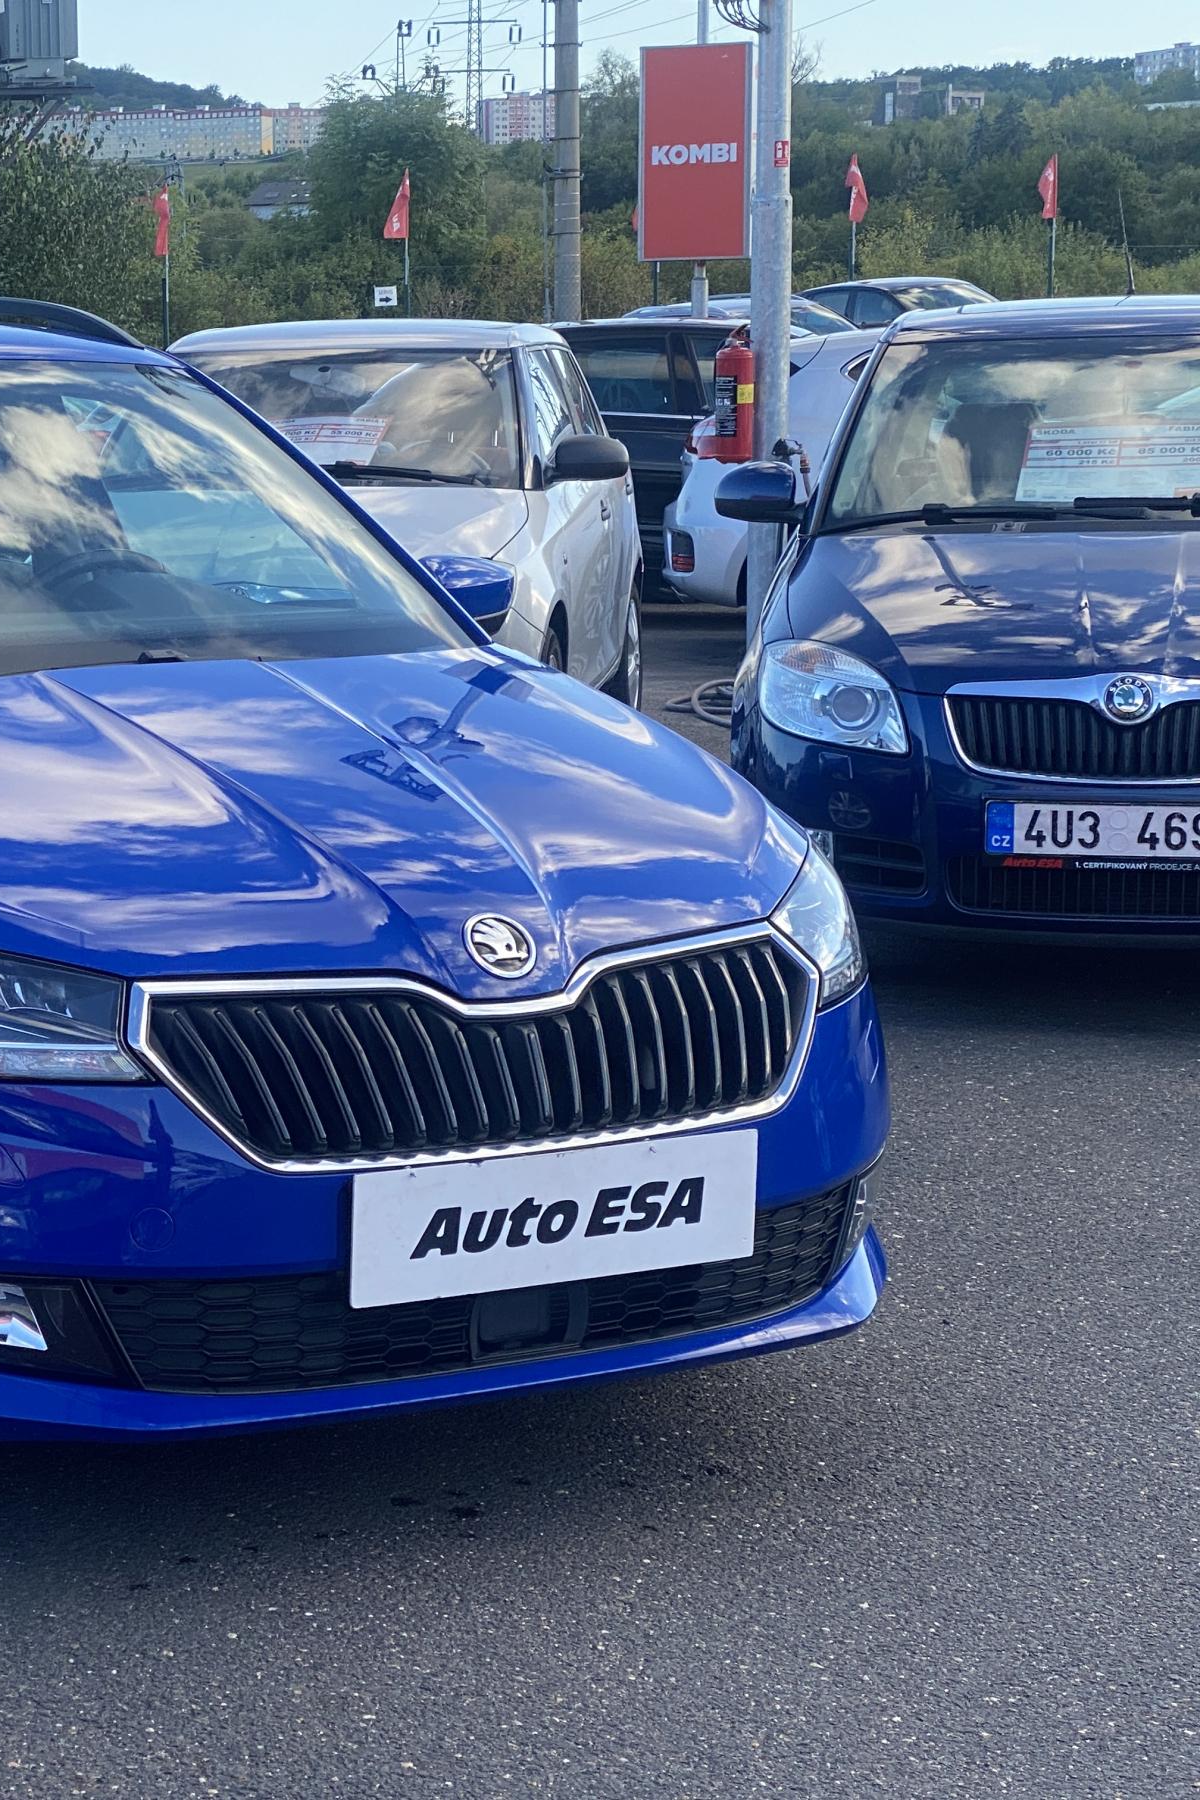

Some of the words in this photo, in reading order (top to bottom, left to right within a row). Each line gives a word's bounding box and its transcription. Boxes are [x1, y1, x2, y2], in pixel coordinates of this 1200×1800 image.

[651, 143, 737, 166] KOMBI
[1045, 449, 1063, 457] 60
[1066, 448, 1093, 456] 000
[1160, 446, 1186, 454] 000
[1024, 809, 1100, 849] 4U3
[991, 835, 1011, 848] CZ
[1003, 857, 1036, 867] Auto
[1036, 858, 1063, 869] ESA
[1083, 861, 1148, 870] CERTIFIKOVANÝ
[1149, 863, 1193, 871] PRODEJCE
[409, 1196, 579, 1260] Auto
[584, 1176, 705, 1237] ESA
